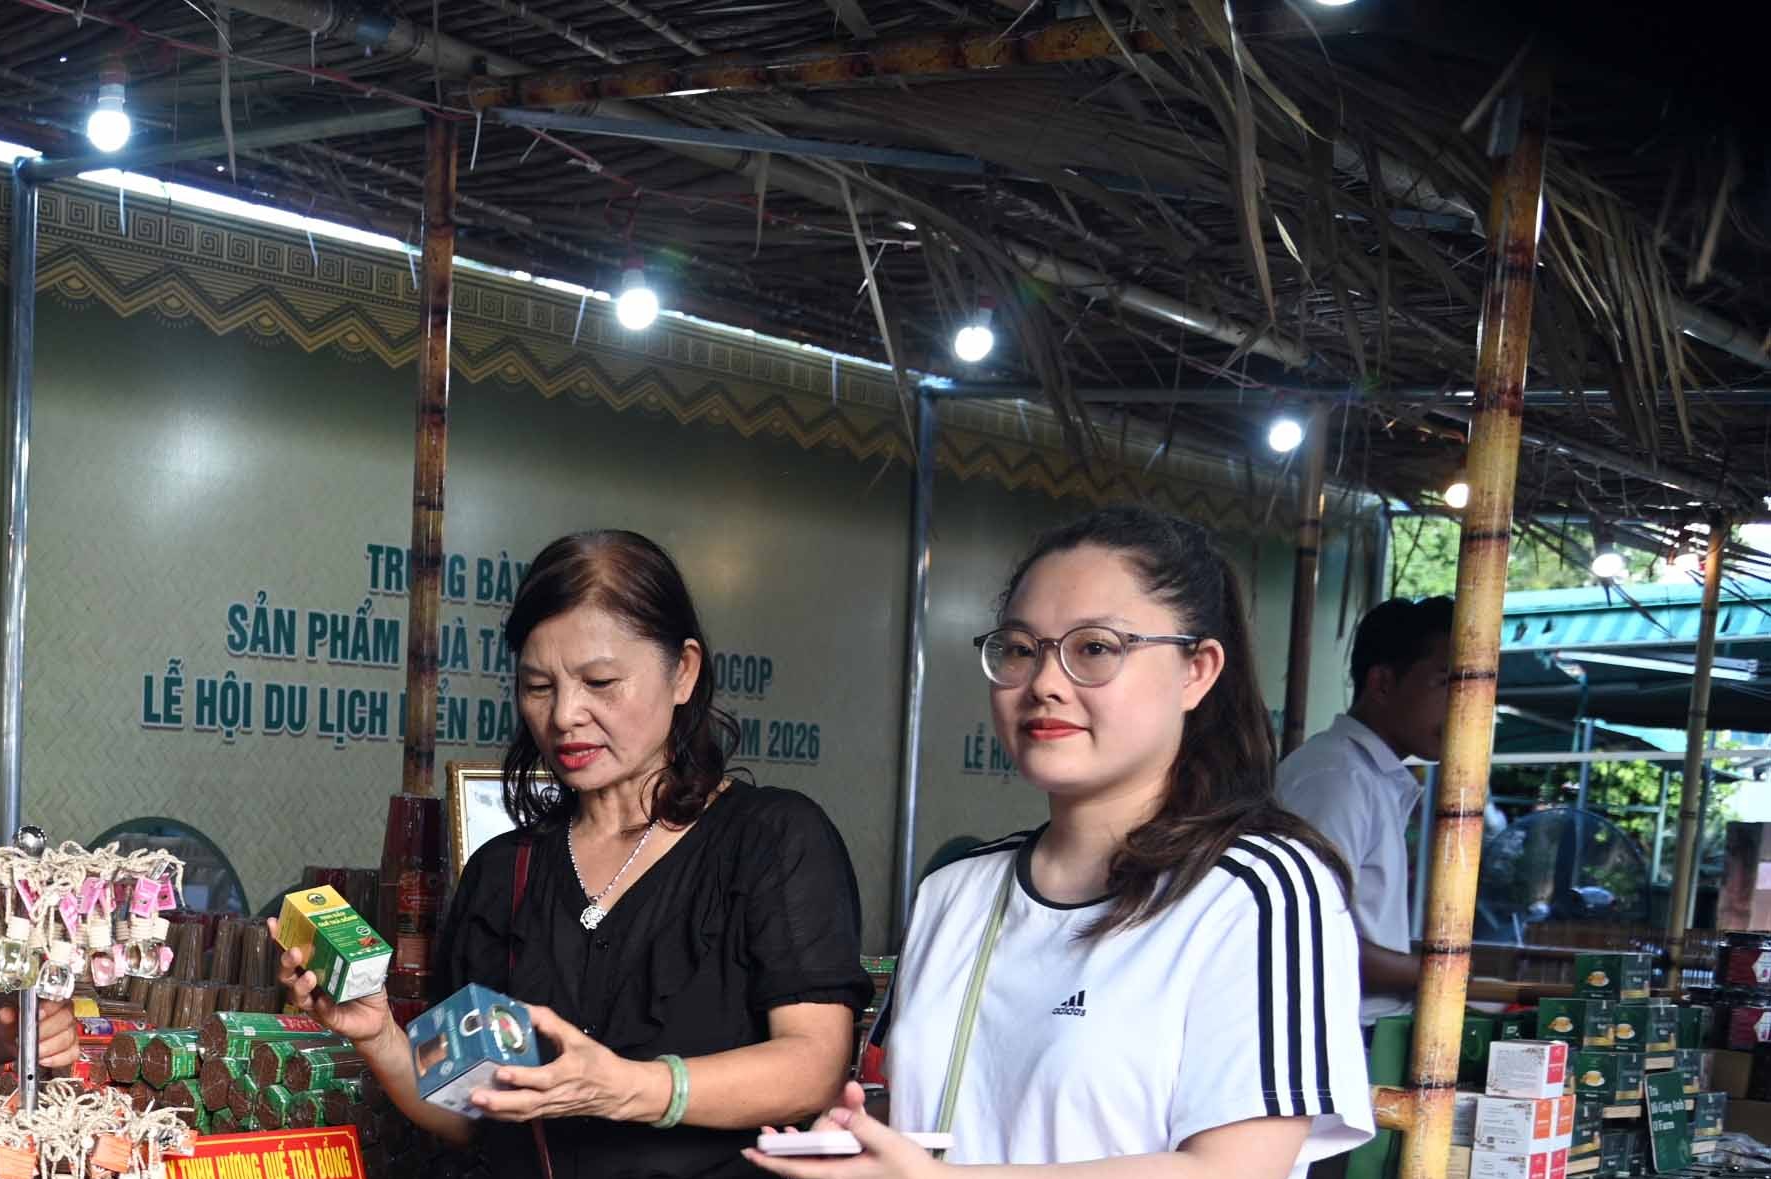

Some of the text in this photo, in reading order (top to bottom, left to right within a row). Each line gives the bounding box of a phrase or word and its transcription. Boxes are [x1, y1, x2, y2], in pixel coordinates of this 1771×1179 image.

[228, 590, 296, 655] SẢN
[308, 599, 400, 664] PHẨM
[143, 659, 183, 724] LỄ
[195, 671, 252, 738] HỘI
[265, 685, 307, 732] DU
[319, 688, 388, 744] LỊCH
[767, 721, 821, 761] 2026
[1052, 1005, 1086, 1017] adidas
[316, 1136, 353, 1179] BỒNG
